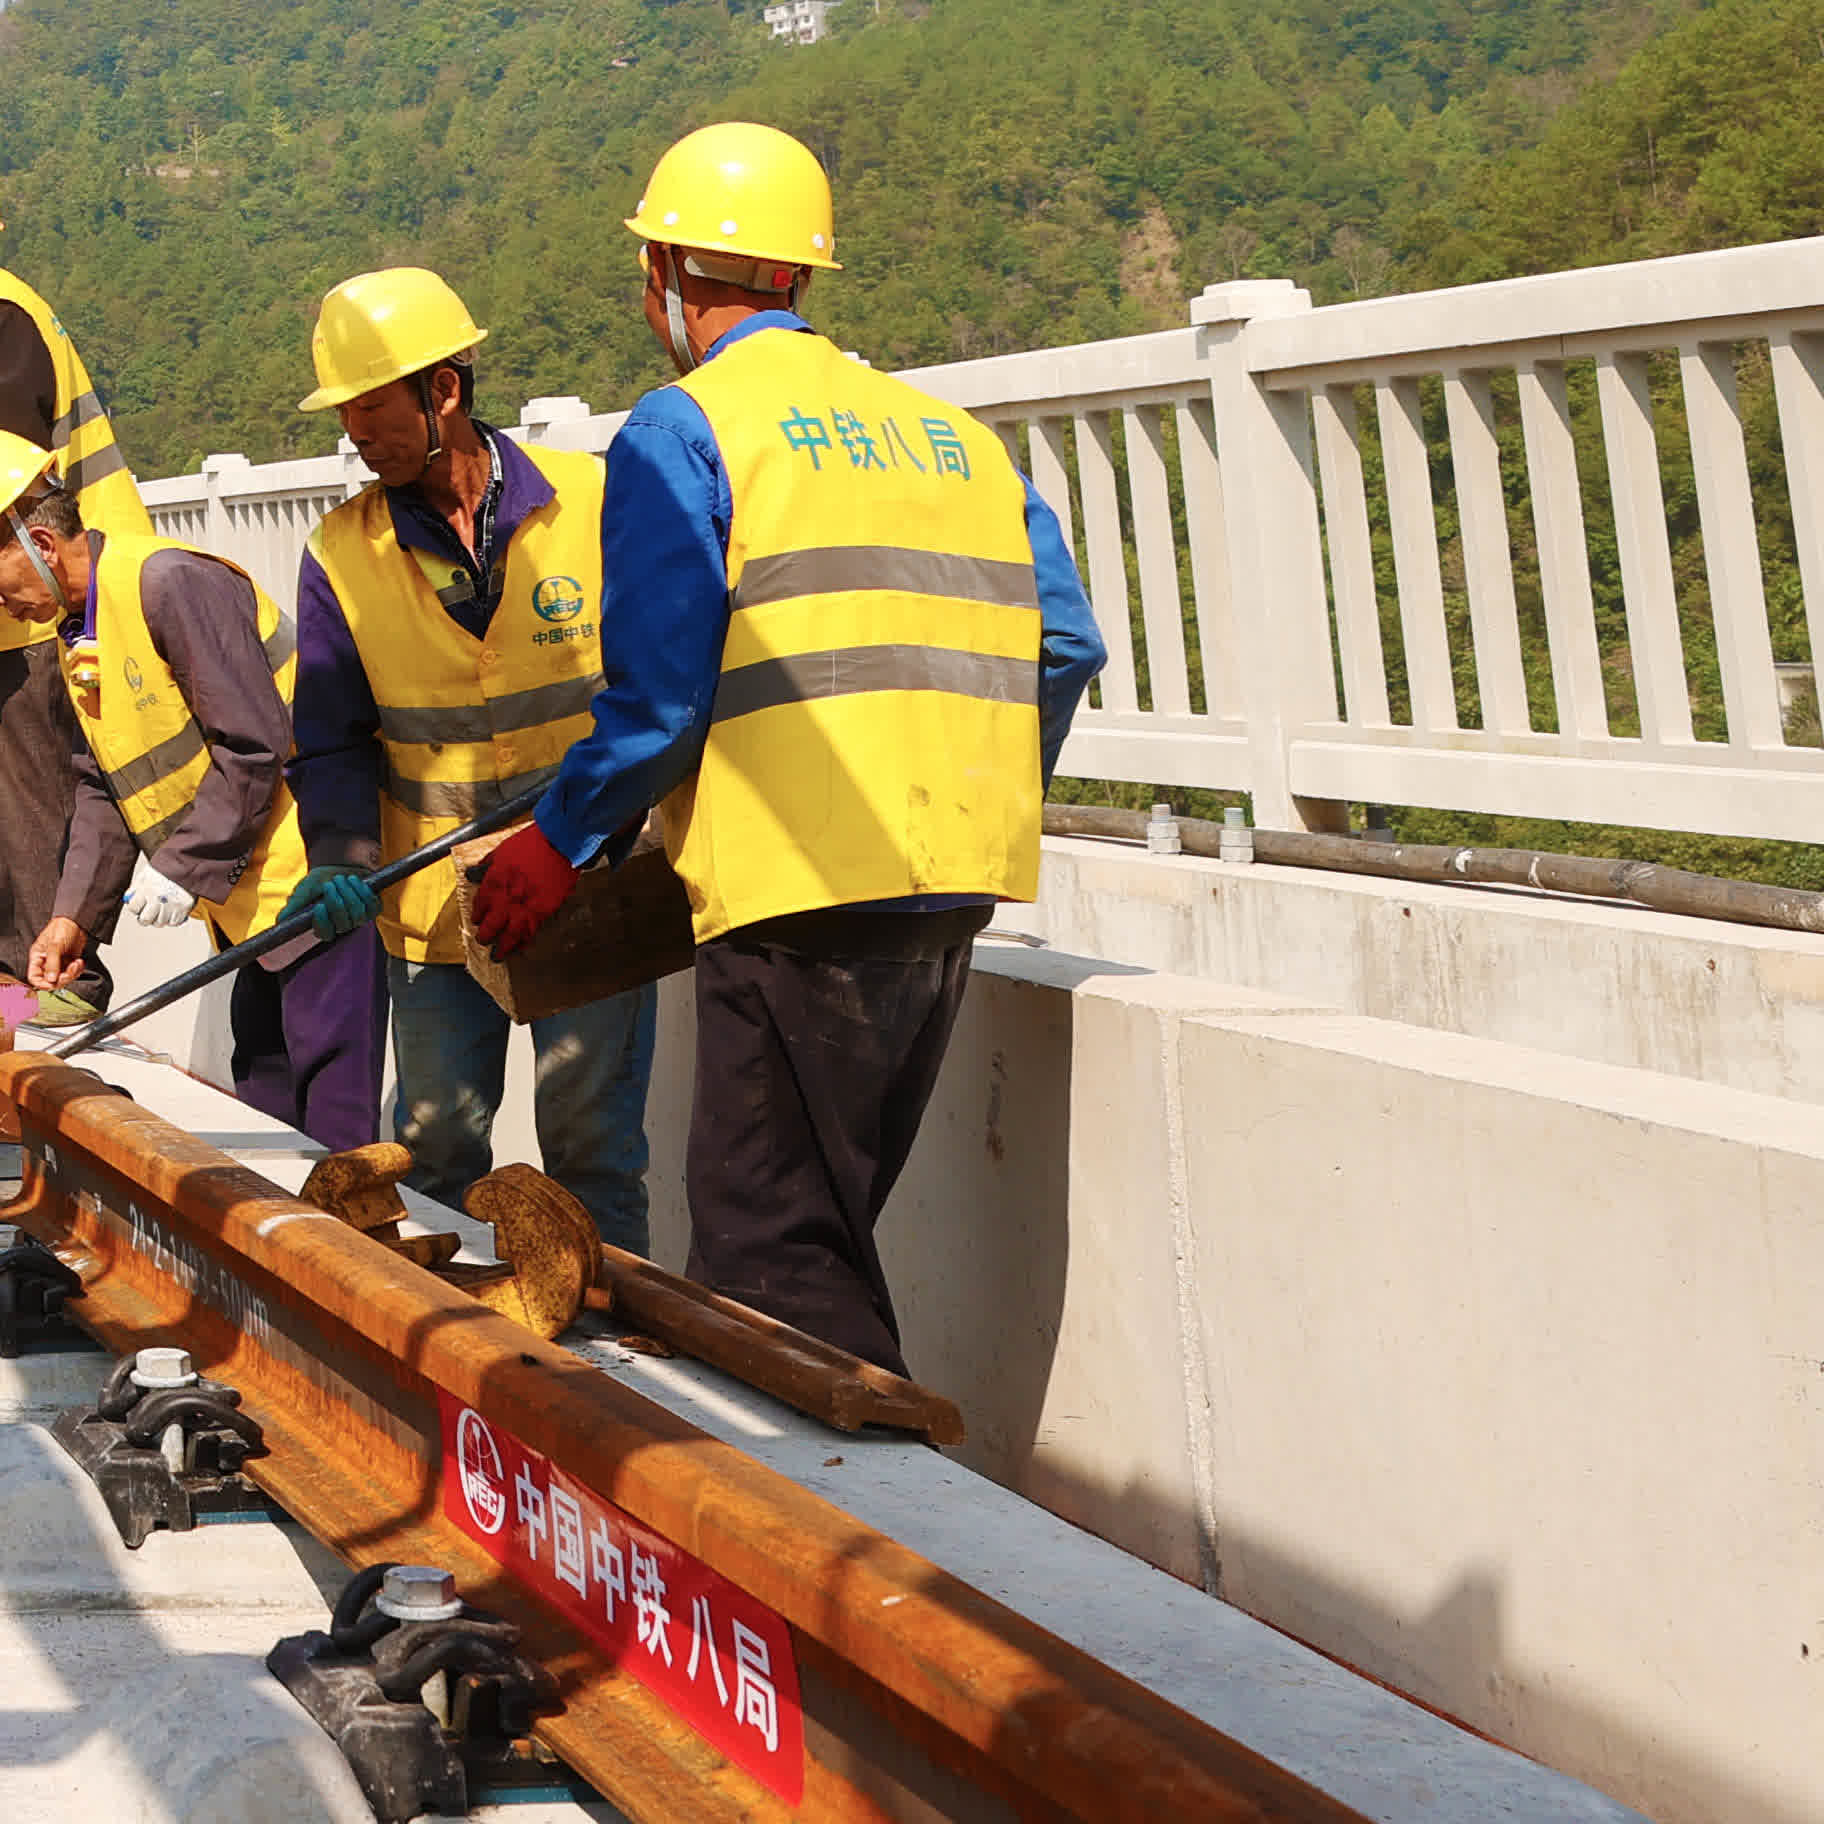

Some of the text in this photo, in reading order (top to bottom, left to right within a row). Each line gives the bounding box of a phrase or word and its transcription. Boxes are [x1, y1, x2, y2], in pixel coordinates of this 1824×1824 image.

[779, 406, 971, 481] 中铁八局
[532, 623, 595, 647] 中国中铁
[514, 1460, 779, 1753] 中国中铁八局
